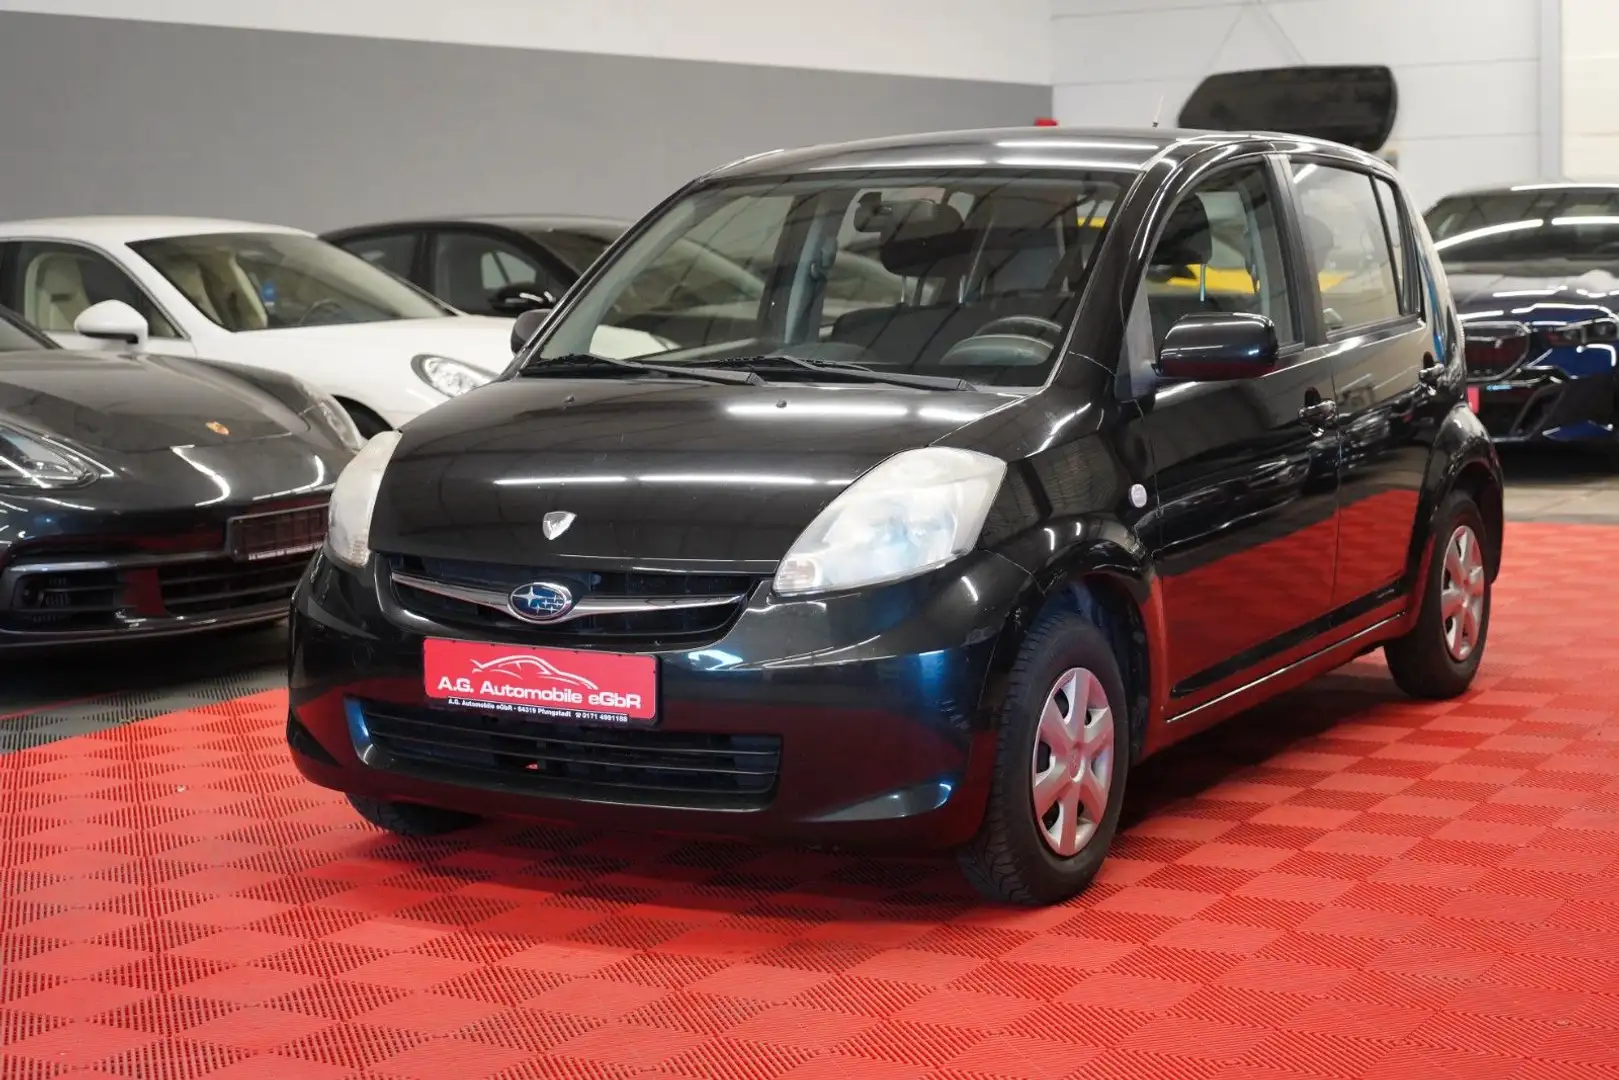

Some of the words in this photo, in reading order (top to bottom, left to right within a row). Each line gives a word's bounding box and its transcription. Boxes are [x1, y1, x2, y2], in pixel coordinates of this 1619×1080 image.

[438, 677, 474, 692] A.G.
[480, 681, 582, 703] Automobile
[589, 692, 641, 708] eGbR
[462, 700, 495, 709] Automobile
[518, 705, 536, 713] 64319
[538, 708, 571, 717] Pfungstadt
